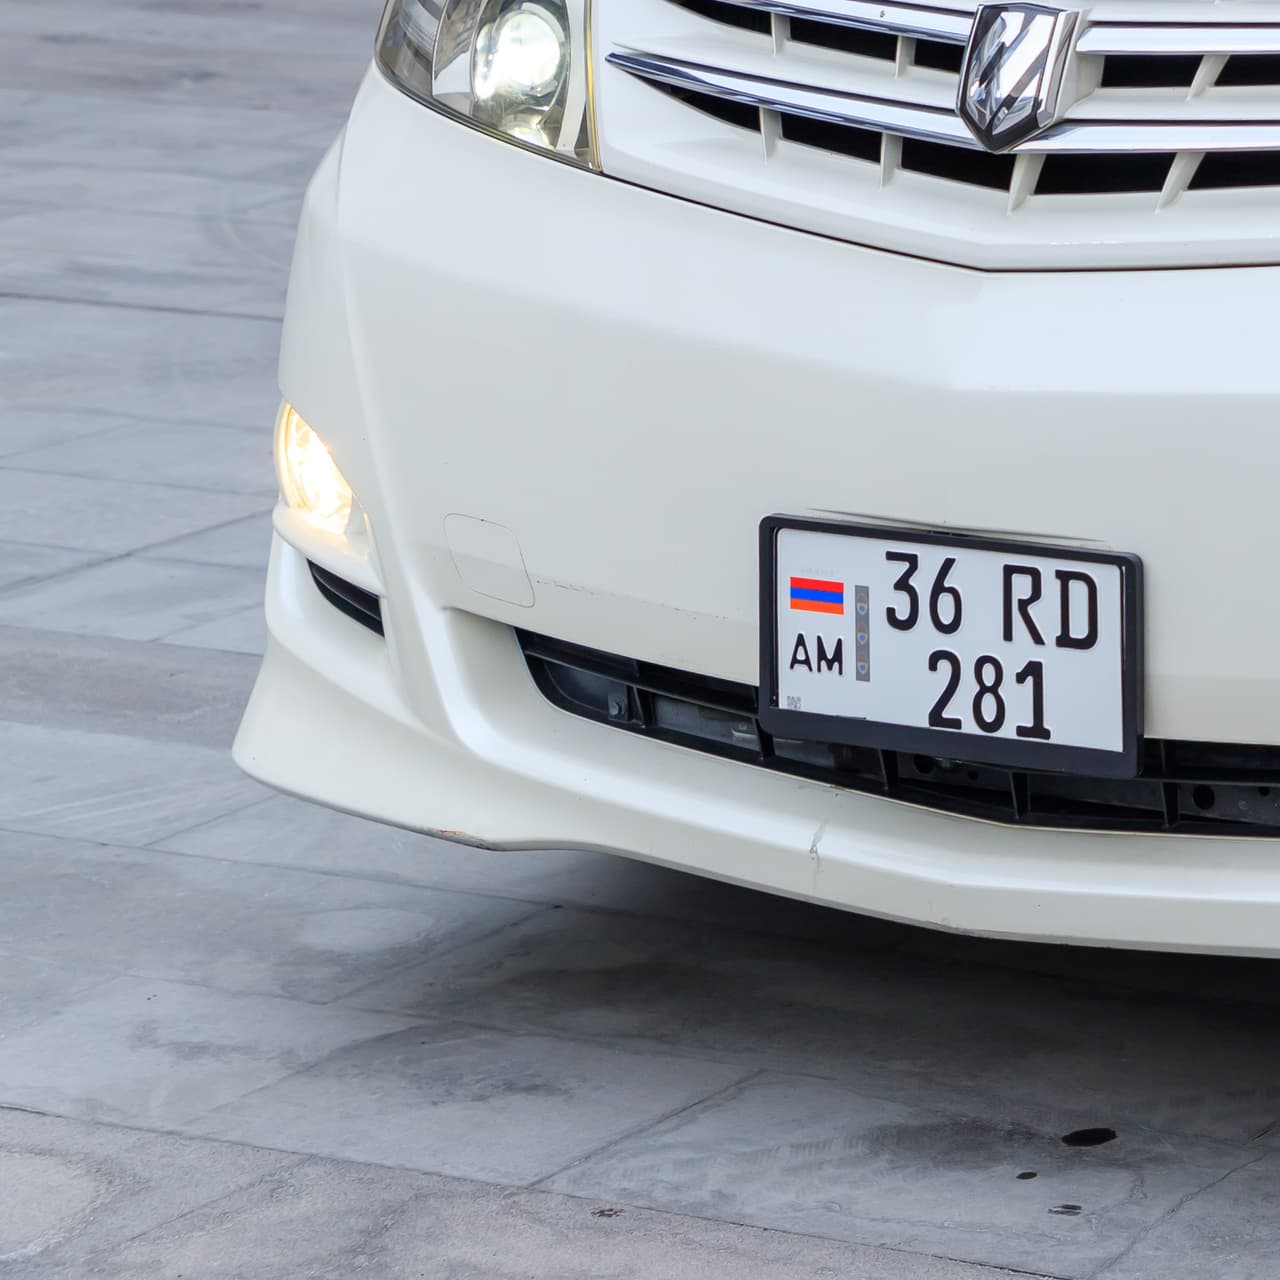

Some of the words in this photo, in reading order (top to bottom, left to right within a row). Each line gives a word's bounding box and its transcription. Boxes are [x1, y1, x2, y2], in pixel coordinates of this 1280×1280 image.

[885, 550, 963, 634] 36
[1002, 564, 1098, 650] RD
[789, 632, 844, 676] AM
[928, 649, 1051, 740] 281
